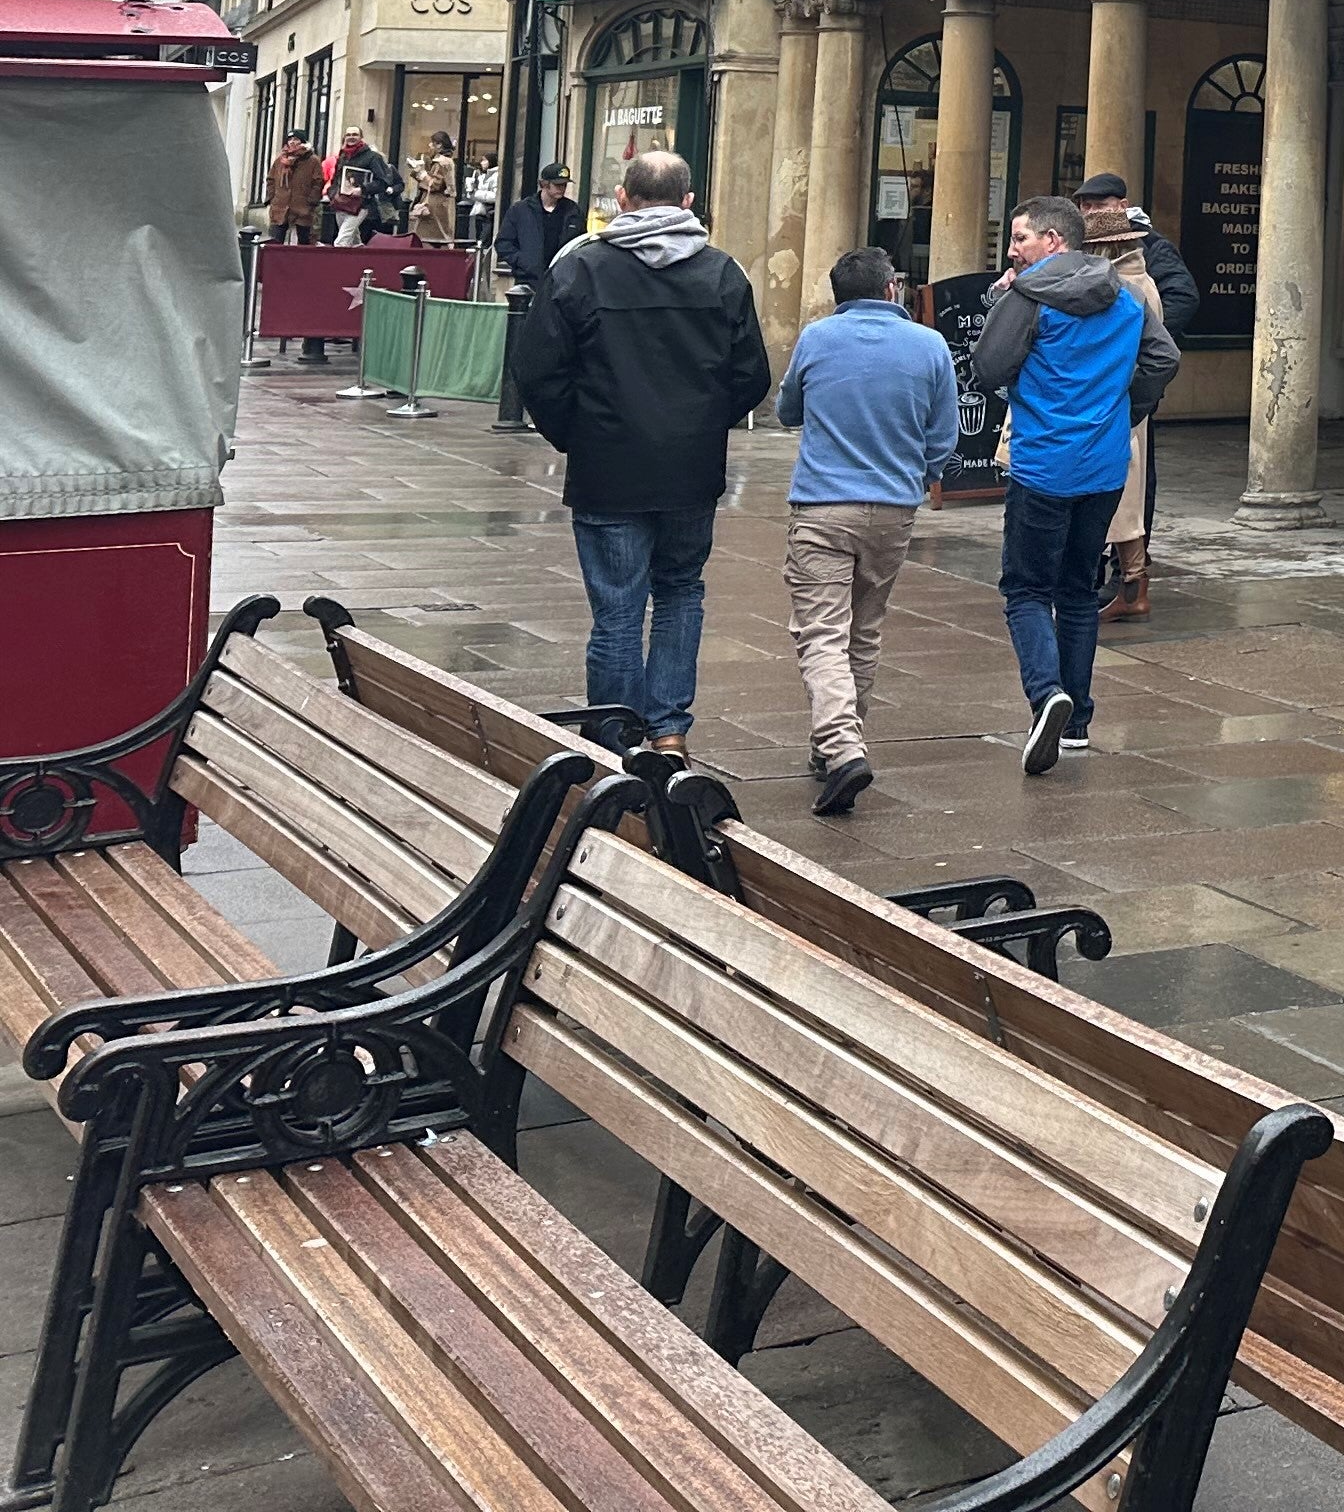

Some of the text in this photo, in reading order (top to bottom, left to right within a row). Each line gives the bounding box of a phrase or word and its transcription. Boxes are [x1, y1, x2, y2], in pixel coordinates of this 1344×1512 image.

[216, 51, 249, 63] COS
[604, 105, 663, 127] LA BAGUETTE
[1214, 163, 1262, 175] FRESH
[1220, 183, 1261, 195] BAKE
[1222, 223, 1259, 234] MADE
[1231, 243, 1250, 254] TO
[1209, 283, 1236, 294] ALL
[963, 458, 988, 468] MADE
